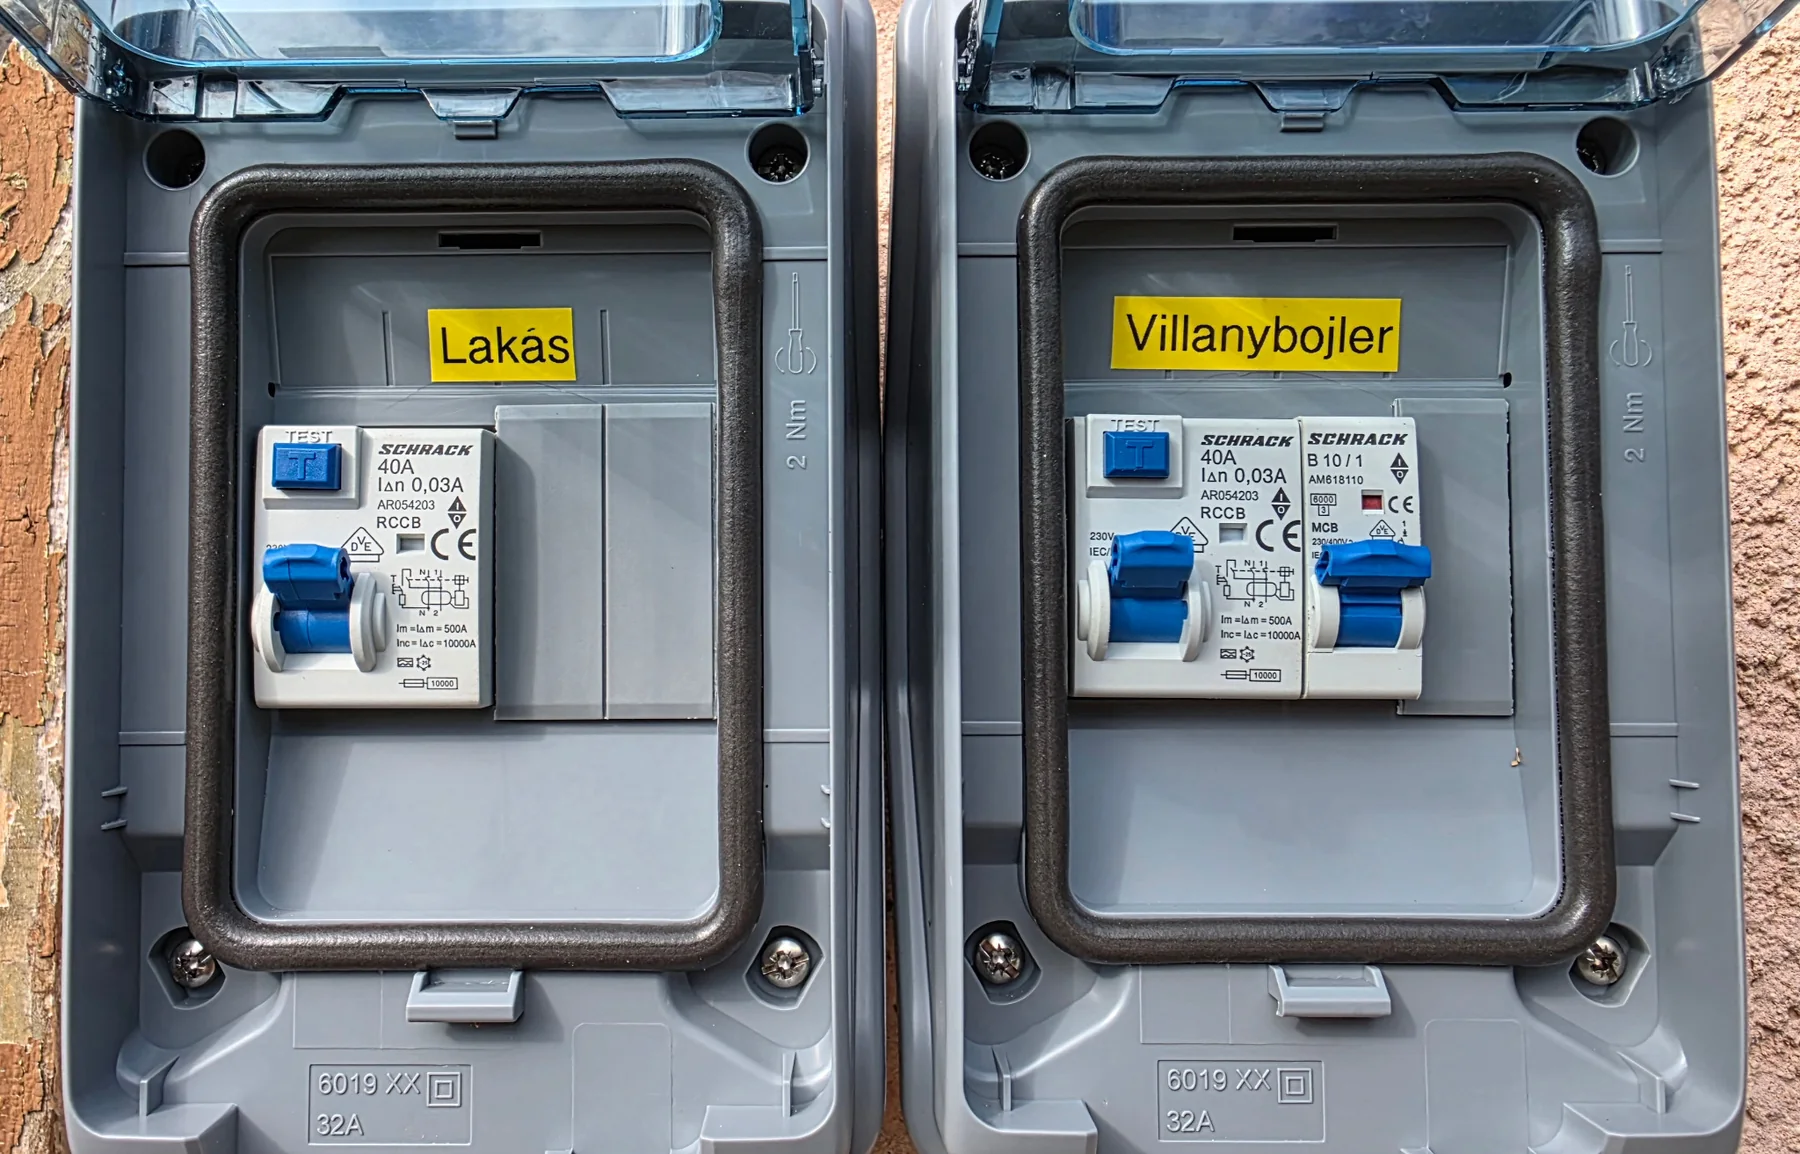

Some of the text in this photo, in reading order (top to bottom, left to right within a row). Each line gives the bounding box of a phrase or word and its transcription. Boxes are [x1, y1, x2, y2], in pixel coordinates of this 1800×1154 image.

[1126, 313, 1394, 360] Villanybojler
[441, 326, 570, 365] Lakás
[1110, 419, 1160, 432] TEST
[1622, 392, 1645, 463] 2 Nm
[285, 430, 333, 443] TEST
[785, 400, 807, 470] 2 Nm
[1200, 434, 1295, 447] SCHRACK
[1307, 432, 1408, 445] SCHRACK
[378, 443, 474, 456] SCHRACK
[1200, 449, 1237, 465] 40A
[1307, 453, 1318, 467] B
[1323, 453, 1342, 467] 10
[1355, 454, 1362, 467] 1
[377, 458, 415, 475] 40A
[1234, 467, 1287, 485] 0,03A
[1308, 475, 1364, 484] AM618110
[411, 477, 464, 494] 0,03A
[1200, 489, 1259, 501] AR054203
[1312, 495, 1334, 504] 6000
[377, 499, 435, 511] AR054203
[1387, 495, 1414, 514] CE
[1200, 506, 1246, 519] RCCB
[376, 516, 421, 529] RCCB
[1311, 522, 1338, 532] MCB
[430, 528, 476, 560] CE
[1268, 616, 1292, 625] 500A
[444, 624, 468, 634] 500A
[1254, 671, 1277, 679] 10000
[318, 1072, 421, 1095] 6019 XX
[1167, 1068, 1272, 1091] 6019 XX
[316, 1113, 365, 1136] 32A
[1166, 1109, 1215, 1133] 32A
